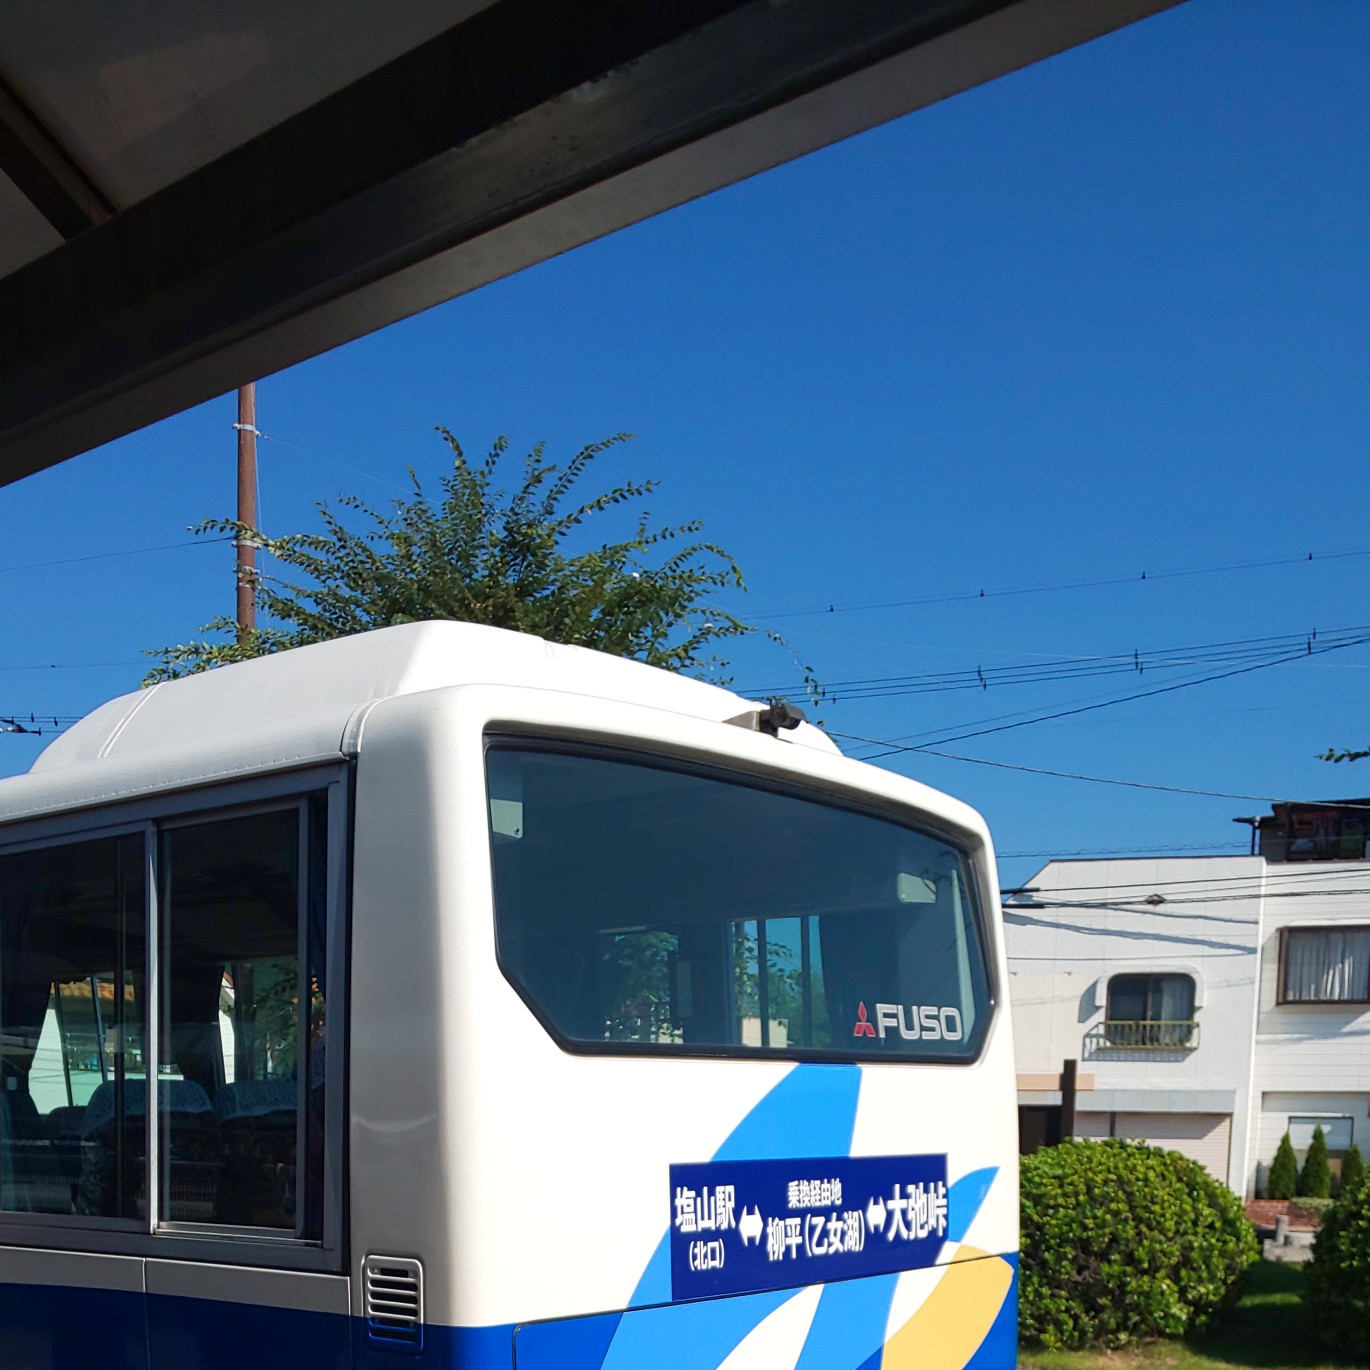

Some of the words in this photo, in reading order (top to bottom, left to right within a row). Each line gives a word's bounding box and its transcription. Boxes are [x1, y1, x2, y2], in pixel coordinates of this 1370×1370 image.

[876, 1003, 962, 1040] FUSO
[674, 1185, 736, 1232] 塩山駅
[787, 1178, 842, 1208] 乗換経由地
[887, 1181, 948, 1241] 大弛峠
[689, 1238, 725, 1271] (北口)
